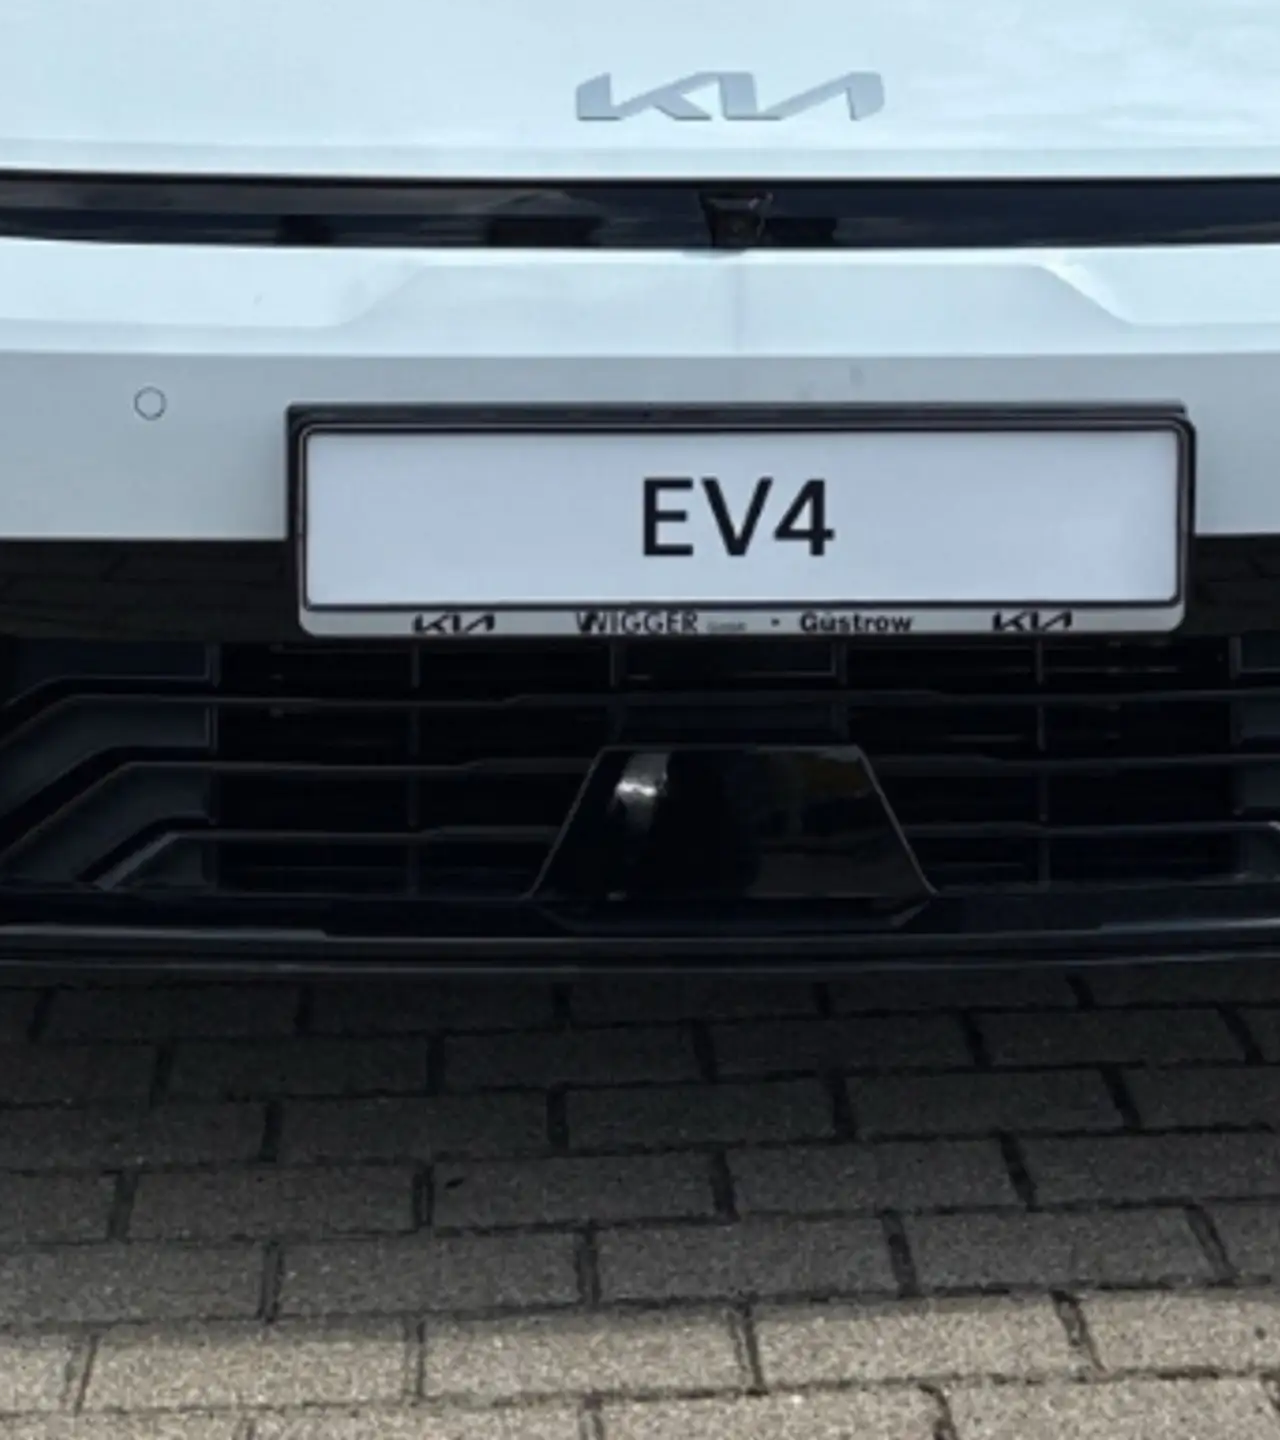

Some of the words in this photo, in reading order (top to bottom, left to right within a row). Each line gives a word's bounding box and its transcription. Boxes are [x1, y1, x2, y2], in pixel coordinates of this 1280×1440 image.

[576, 71, 885, 121] KIA
[643, 477, 835, 556] EV4
[412, 612, 495, 634] KIA
[576, 611, 699, 633] WIGGER
[799, 610, 914, 634] Güstrow
[993, 610, 1072, 633] KIA
